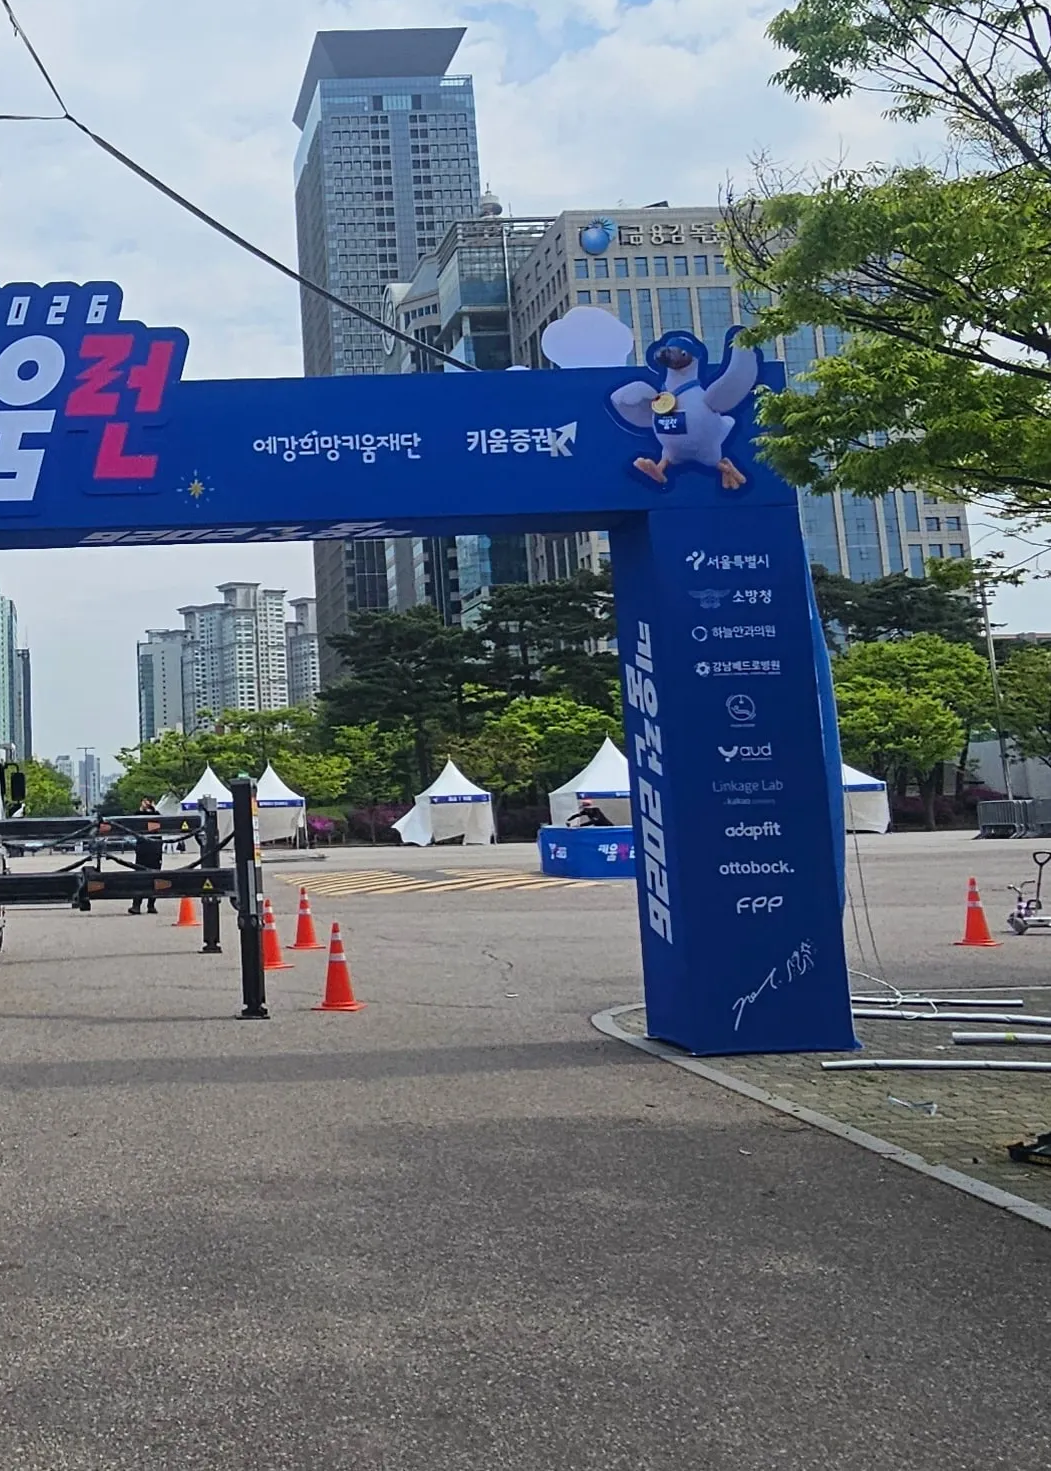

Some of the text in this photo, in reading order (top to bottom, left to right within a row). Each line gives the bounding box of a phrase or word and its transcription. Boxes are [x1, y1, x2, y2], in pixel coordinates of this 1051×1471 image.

[466, 426, 552, 454] 키움증권
[707, 553, 770, 570] 서울특별시
[732, 589, 772, 604] 소방청
[712, 625, 776, 639] 하늘안과의원
[761, 778, 784, 792] Lab
[725, 822, 781, 840] adapfit
[638, 776, 674, 945] 2026
[719, 860, 795, 875] ottobock.
